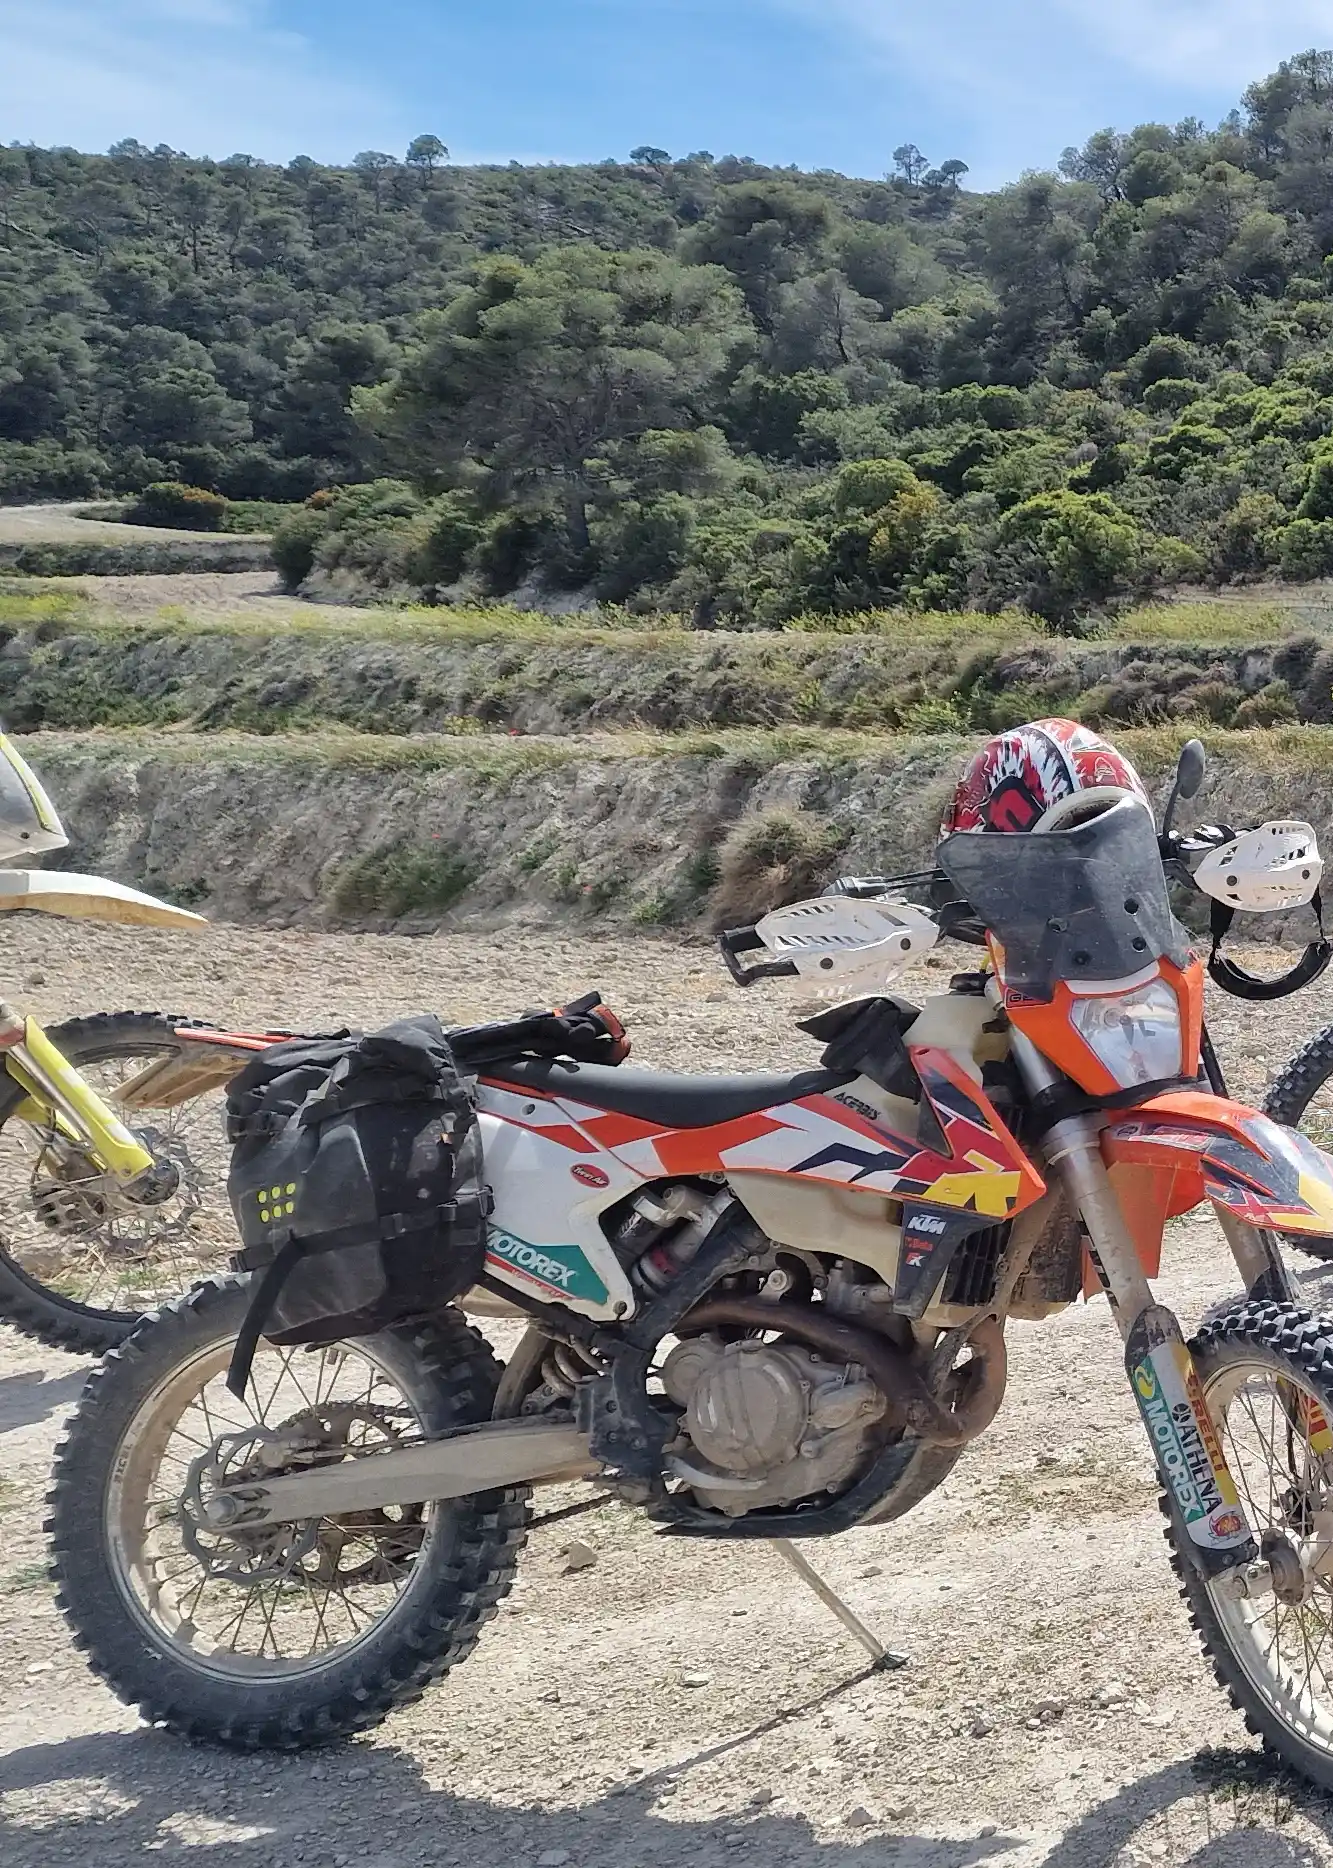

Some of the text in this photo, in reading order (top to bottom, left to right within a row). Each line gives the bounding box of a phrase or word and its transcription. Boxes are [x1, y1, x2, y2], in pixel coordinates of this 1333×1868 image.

[834, 1091, 881, 1121] ACERBIS
[907, 1214, 948, 1235] KTM
[1144, 1399, 1201, 1519] MOTOREX
[1176, 1424, 1223, 1515] ATHENA
